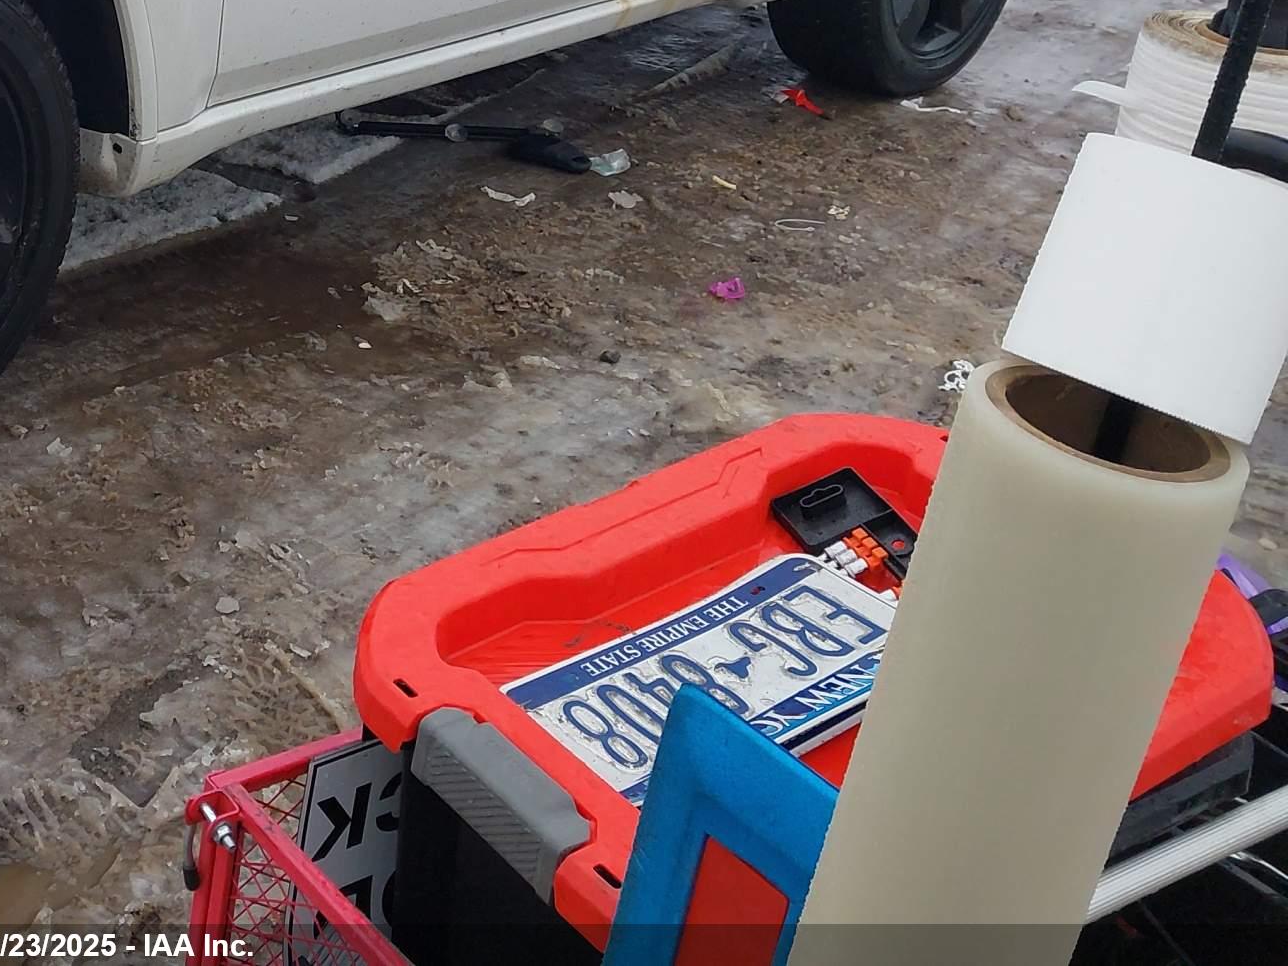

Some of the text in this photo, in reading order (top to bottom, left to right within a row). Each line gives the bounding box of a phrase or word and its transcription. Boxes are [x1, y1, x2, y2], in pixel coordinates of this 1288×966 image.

[580, 595, 749, 677] THE EMPIRE STATE
[794, 664, 875, 711] NEW
